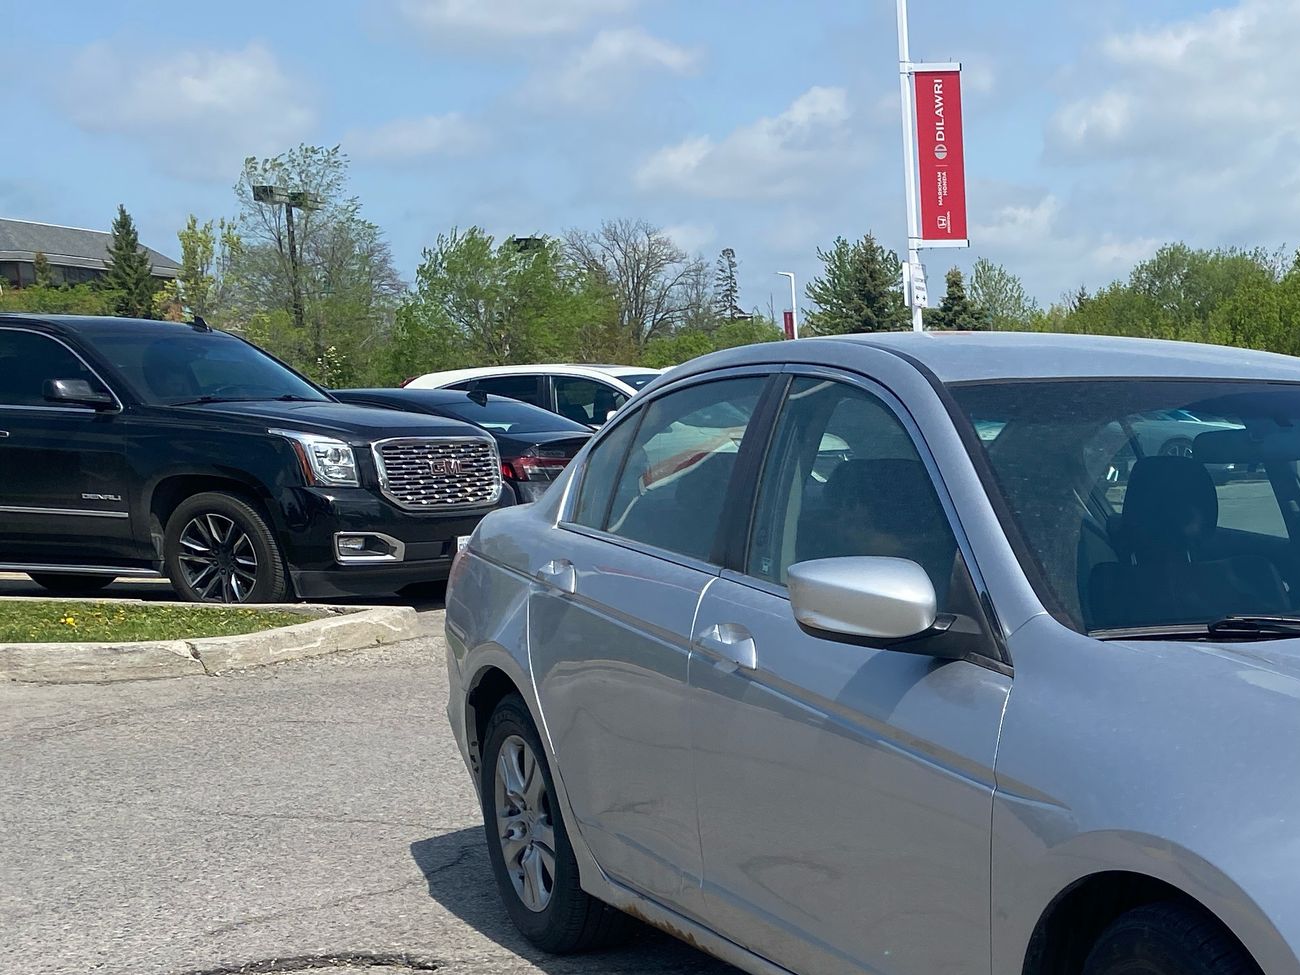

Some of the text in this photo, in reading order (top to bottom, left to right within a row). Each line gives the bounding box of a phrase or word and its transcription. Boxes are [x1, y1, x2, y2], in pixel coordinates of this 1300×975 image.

[934, 79, 945, 141] DILAWRI
[430, 459, 470, 475] GMC
[81, 492, 122, 501] DENALI
